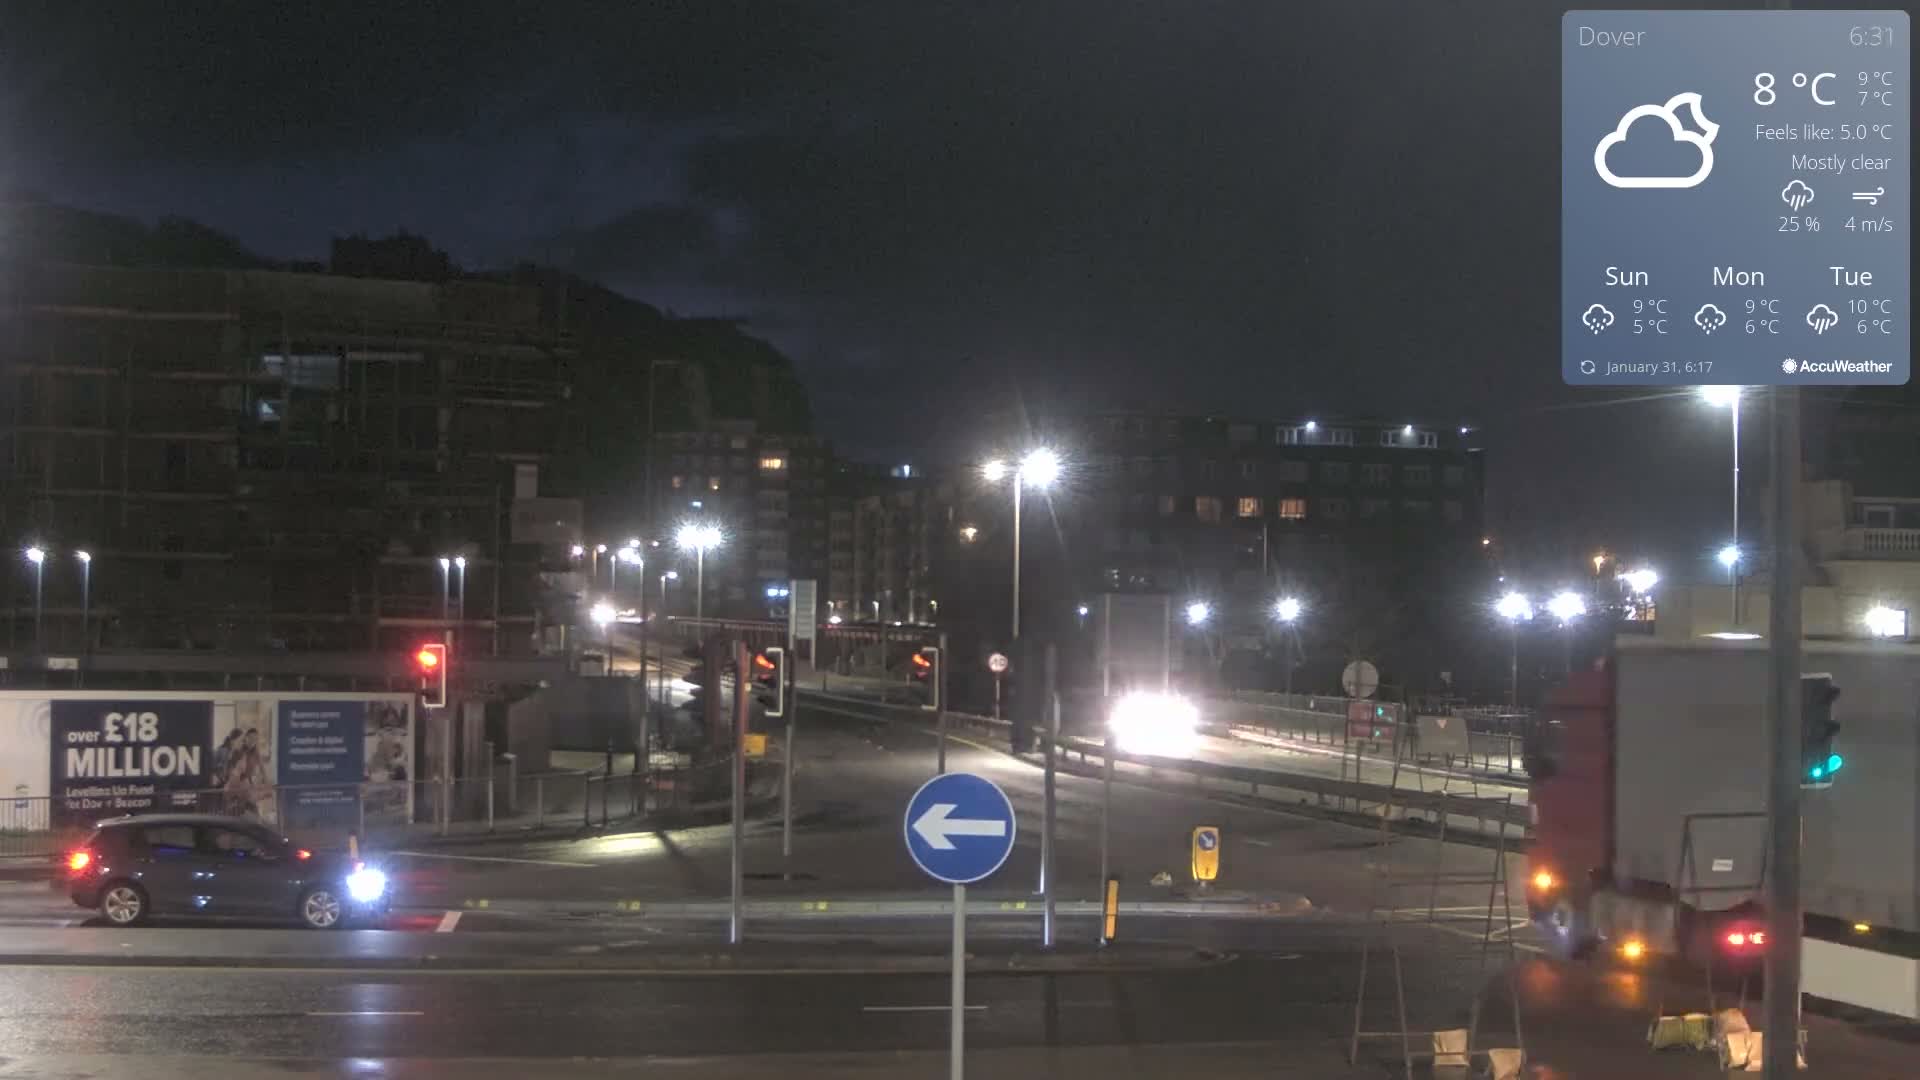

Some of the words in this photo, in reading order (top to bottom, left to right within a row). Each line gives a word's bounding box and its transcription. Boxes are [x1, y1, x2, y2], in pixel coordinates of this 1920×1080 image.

[68, 730, 100, 743] over
[105, 711, 158, 742] £18
[66, 745, 201, 778] MILLION
[129, 784, 154, 796] Fund
